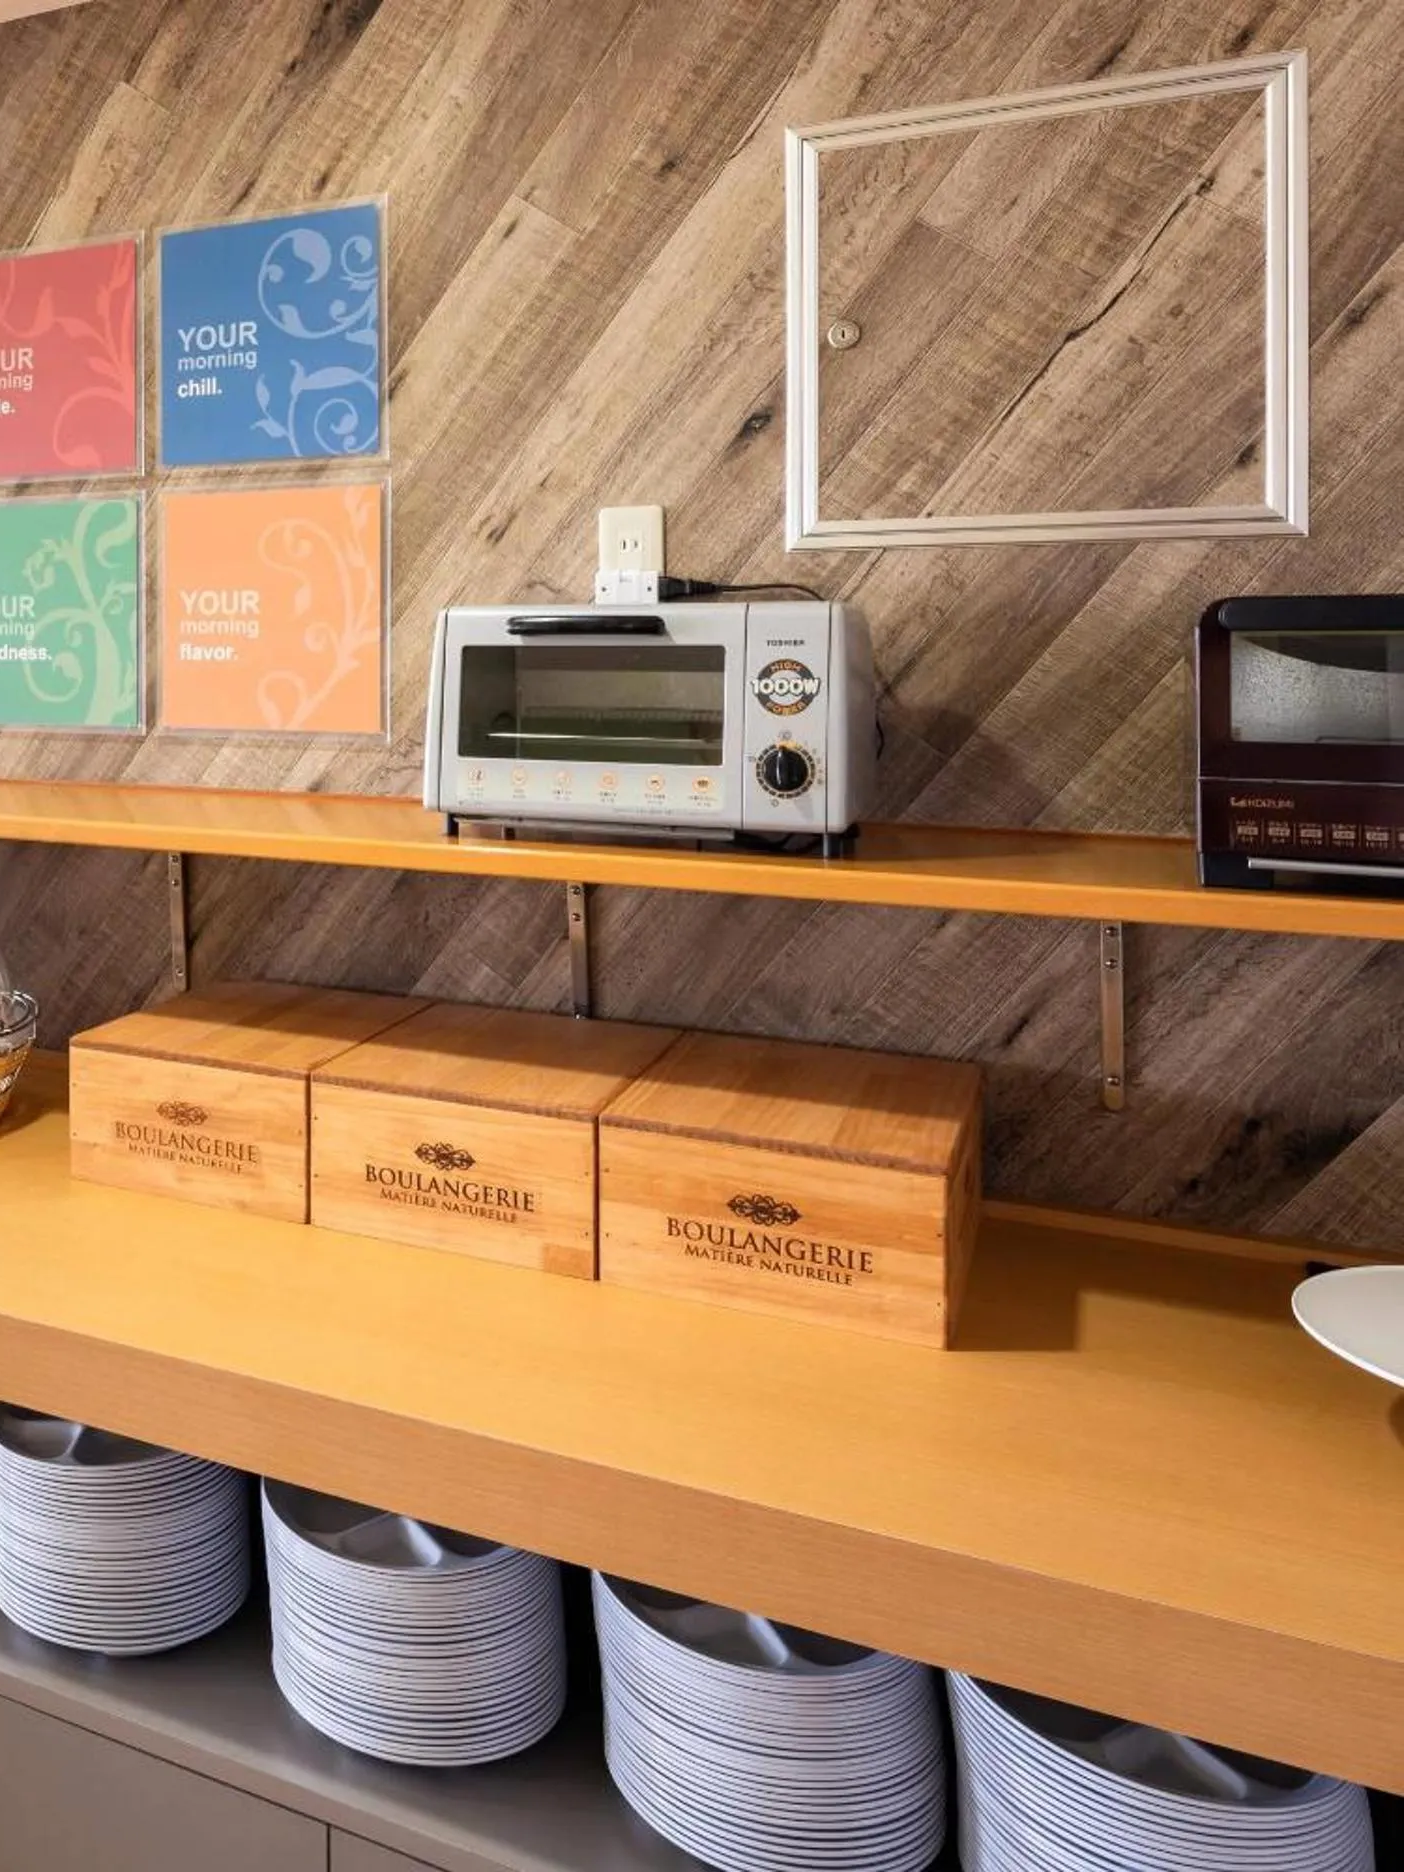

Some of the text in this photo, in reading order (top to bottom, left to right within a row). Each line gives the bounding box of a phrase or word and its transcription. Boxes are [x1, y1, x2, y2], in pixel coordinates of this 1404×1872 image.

[177, 320, 259, 352] YOUR
[177, 349, 258, 372] morning
[177, 378, 223, 398] chill.
[179, 590, 261, 616] YOUR
[179, 617, 260, 639] morning
[179, 644, 239, 661] flavor.
[750, 677, 822, 696] 1000W
[114, 1121, 259, 1163] BOULANGERIE
[179, 1152, 242, 1175] NATURELLE
[365, 1163, 535, 1213] BOULANGERIE
[441, 1202, 517, 1224] NATURELLE
[666, 1216, 874, 1274] BOULANGERIE
[759, 1259, 853, 1287] NATURELLE
